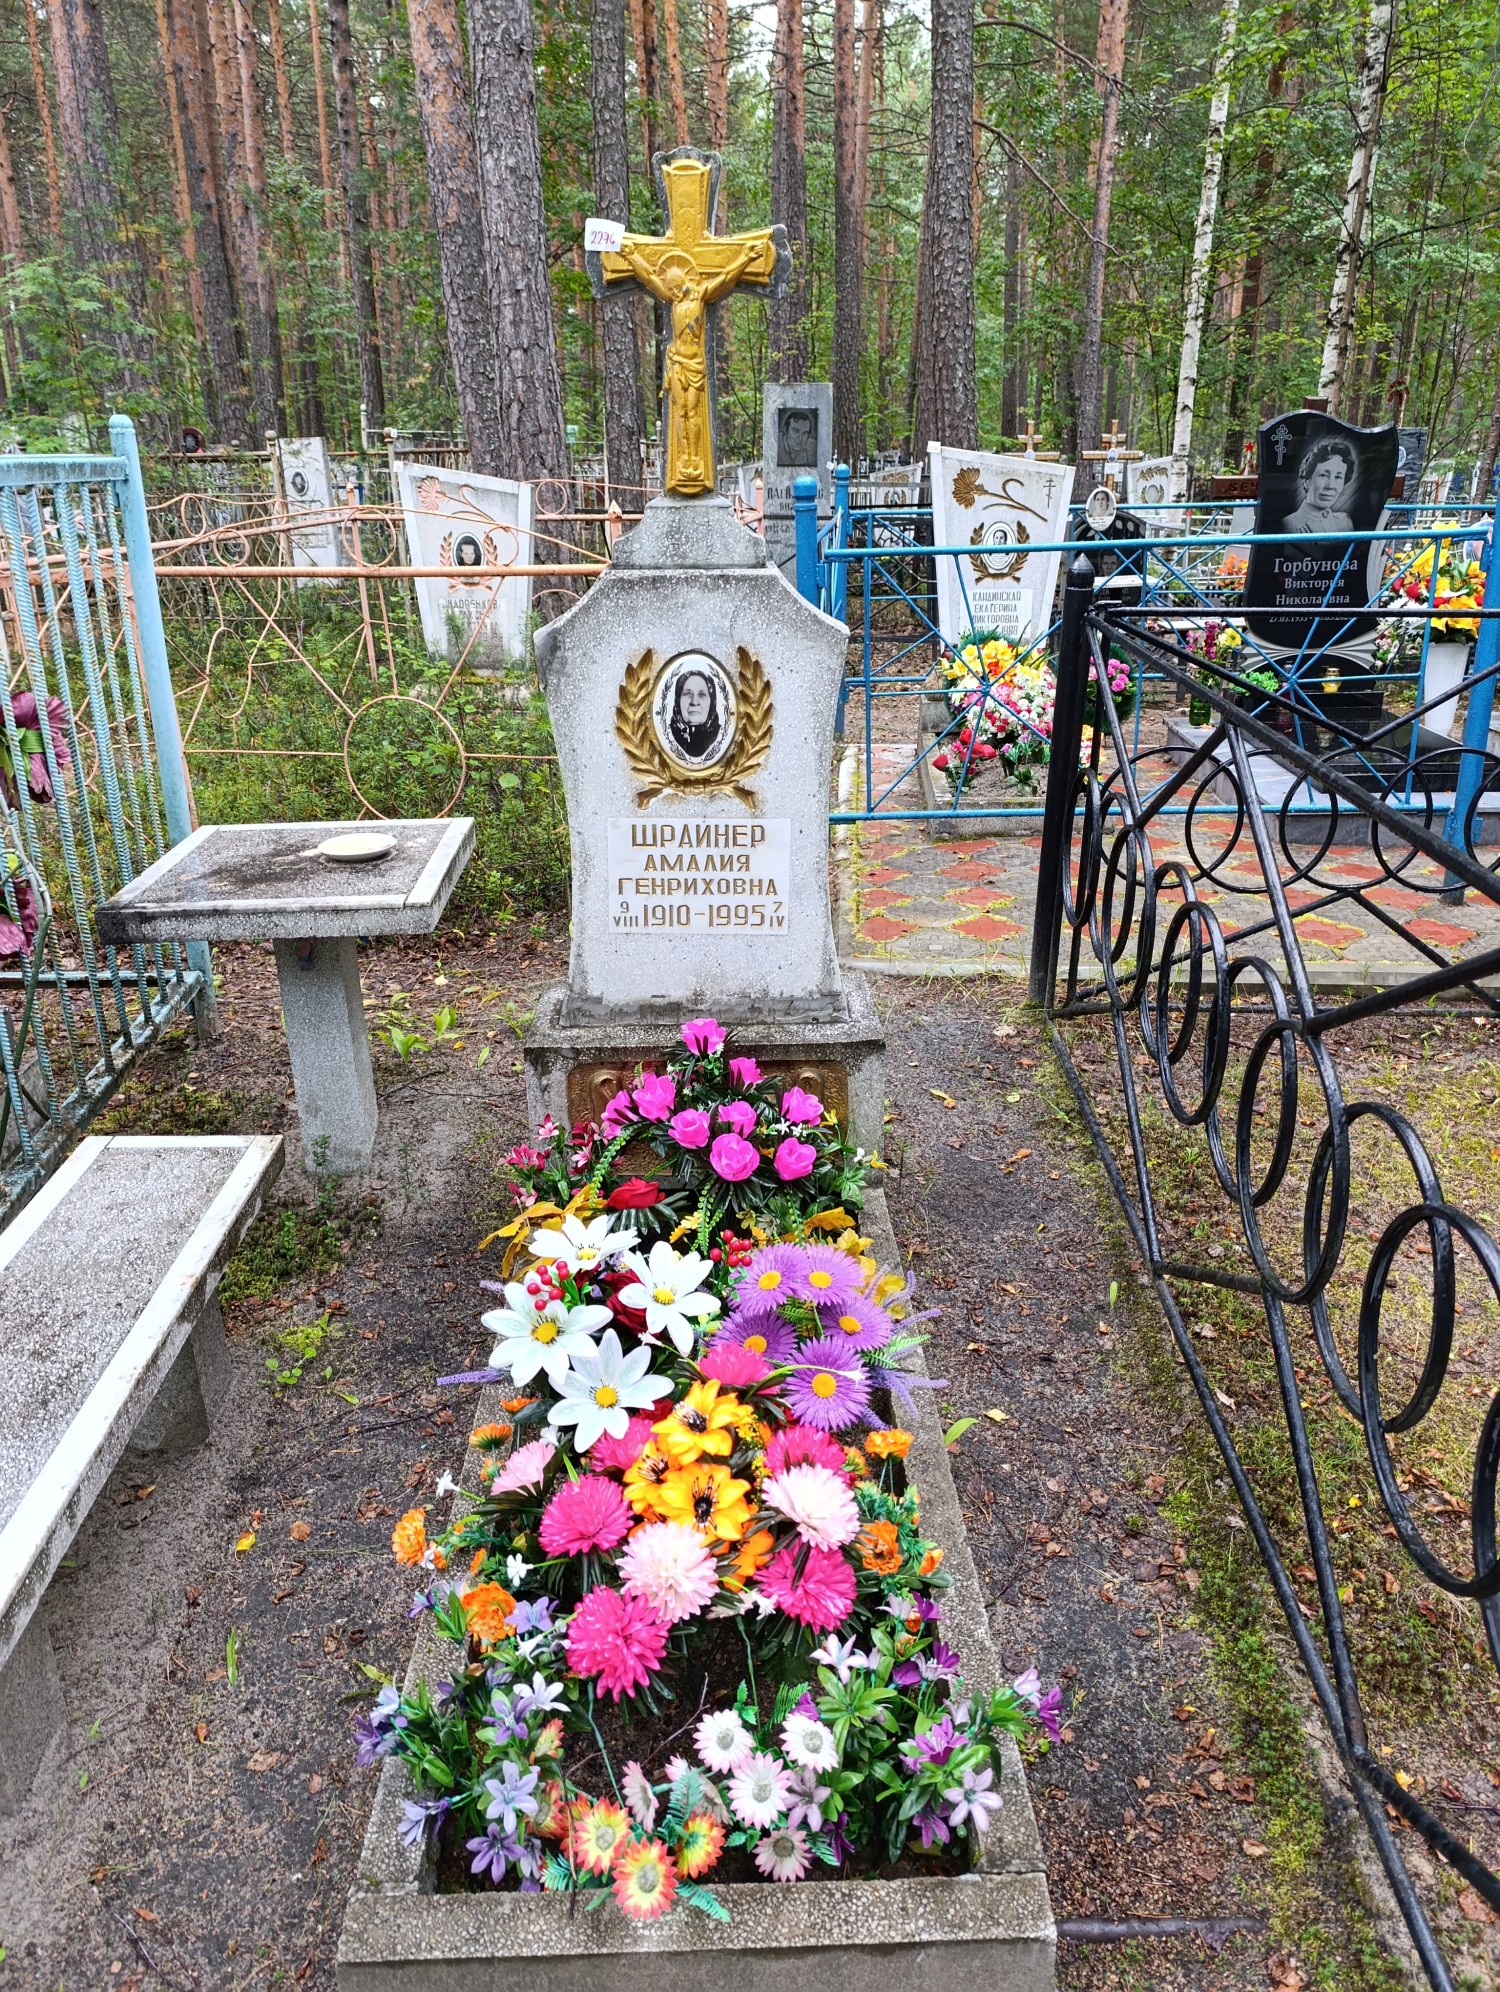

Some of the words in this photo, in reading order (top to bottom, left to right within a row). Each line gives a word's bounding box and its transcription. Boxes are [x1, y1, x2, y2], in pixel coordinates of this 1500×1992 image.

[590, 231, 616, 245] 2276
[972, 590, 1022, 602] КАНДИНСКАЯ
[974, 603, 1018, 613] ЕКАТЕРИНА
[643, 853, 751, 873] АМАЛИЯ
[617, 877, 778, 897] ГЕНРИХОВНА
[619, 900, 630, 914] 9
[772, 900, 783, 913] 7
[613, 914, 639, 928] VIII
[769, 914, 786, 928] IV
